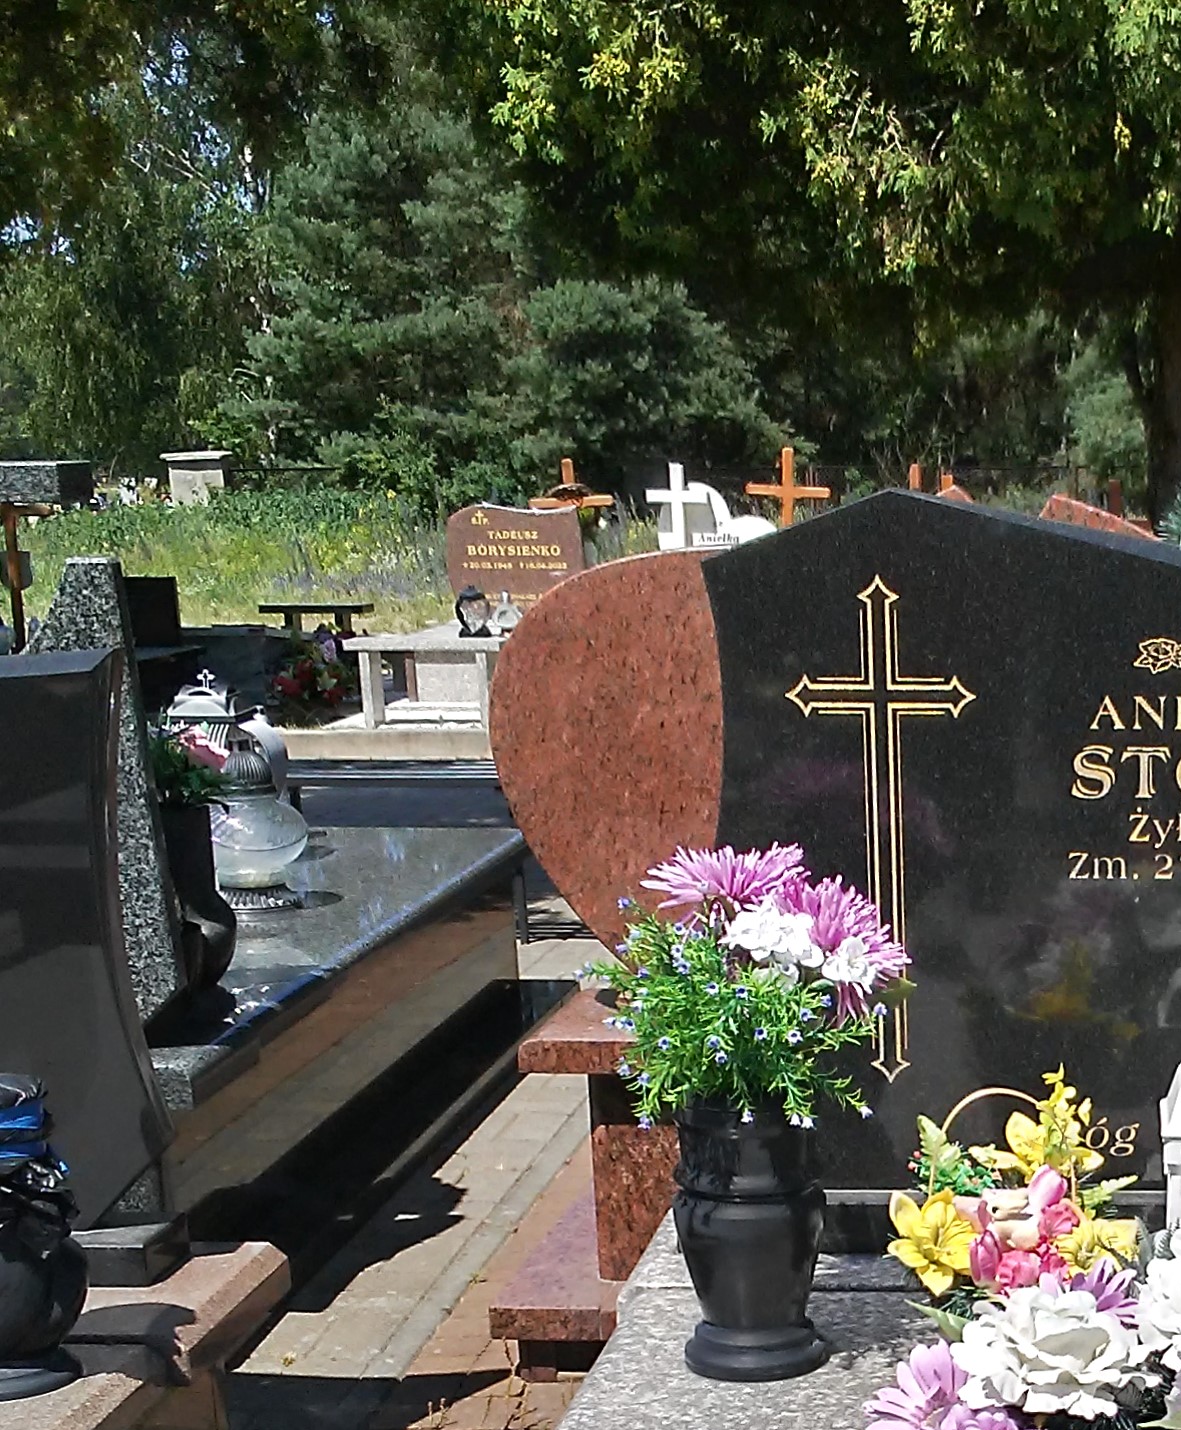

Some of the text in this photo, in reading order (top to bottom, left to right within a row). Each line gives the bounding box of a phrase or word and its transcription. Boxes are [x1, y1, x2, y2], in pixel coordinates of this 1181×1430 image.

[487, 530, 538, 540] TADEUSZ
[467, 545, 561, 556] BORYSIENKO
[1068, 852, 1139, 880] Zm.
[1085, 1117, 1140, 1156] óg
